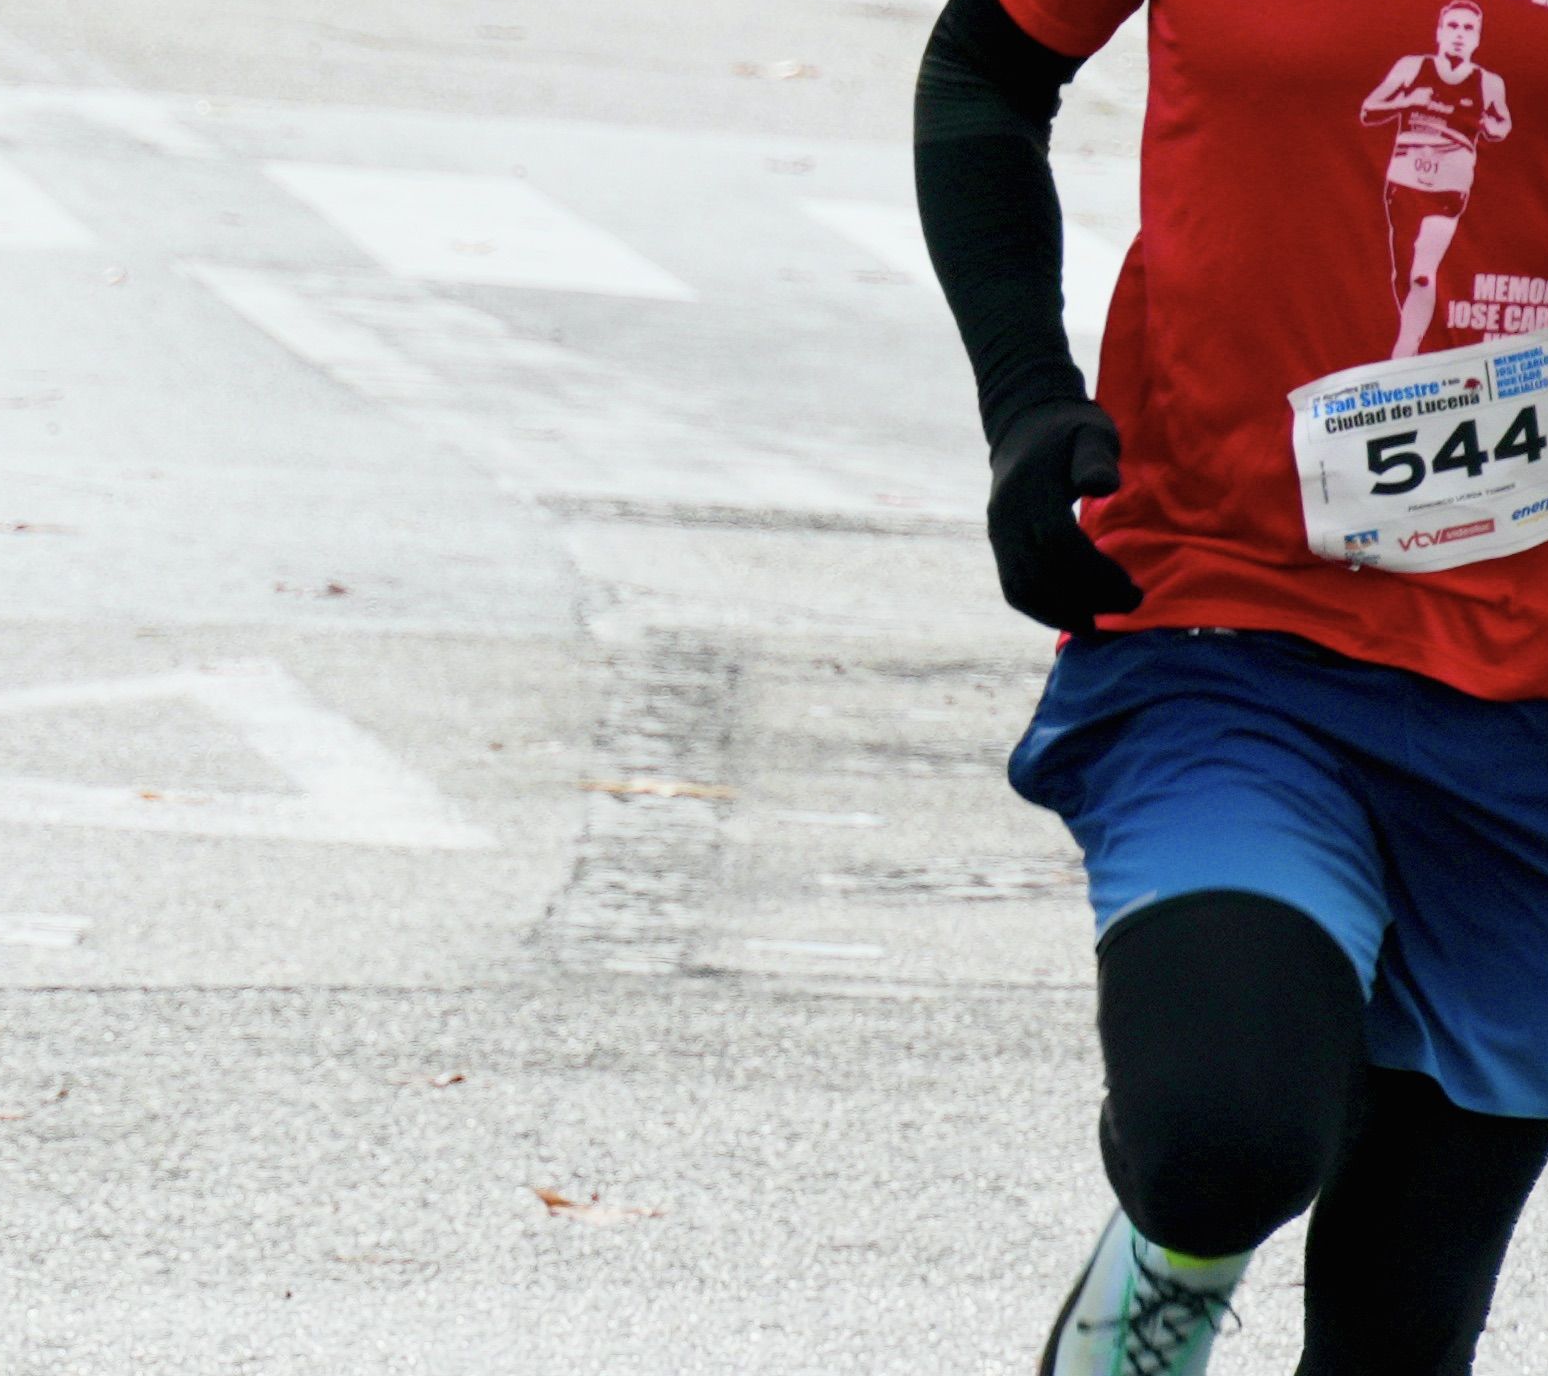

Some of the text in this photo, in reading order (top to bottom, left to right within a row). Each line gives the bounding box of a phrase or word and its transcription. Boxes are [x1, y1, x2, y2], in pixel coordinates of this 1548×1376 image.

[1324, 395, 1357, 415] San
[1359, 381, 1441, 409] Silvestre
[1325, 392, 1482, 435] Ciudad de Lucena
[1366, 405, 1548, 496] 544
